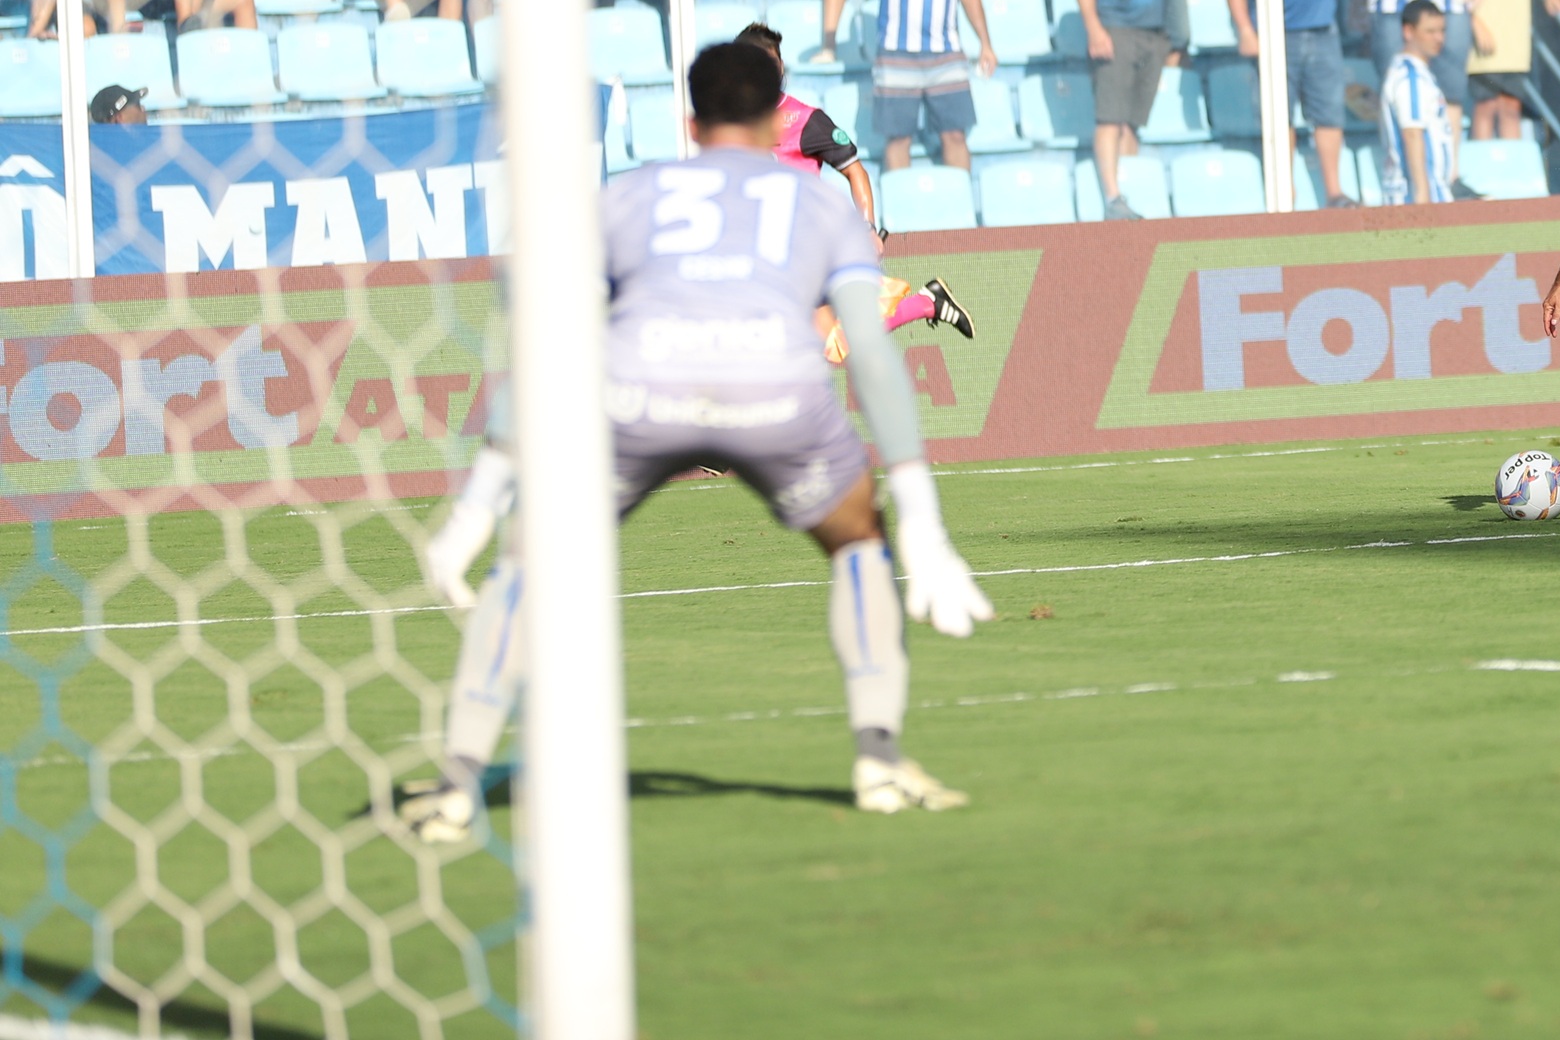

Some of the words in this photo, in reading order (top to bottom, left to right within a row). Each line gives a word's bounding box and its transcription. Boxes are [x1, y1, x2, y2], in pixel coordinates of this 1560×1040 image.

[651, 166, 798, 267] 31
[1198, 252, 1551, 390] Fort
[0, 325, 298, 460] ort
[1504, 453, 1551, 480] Topper
